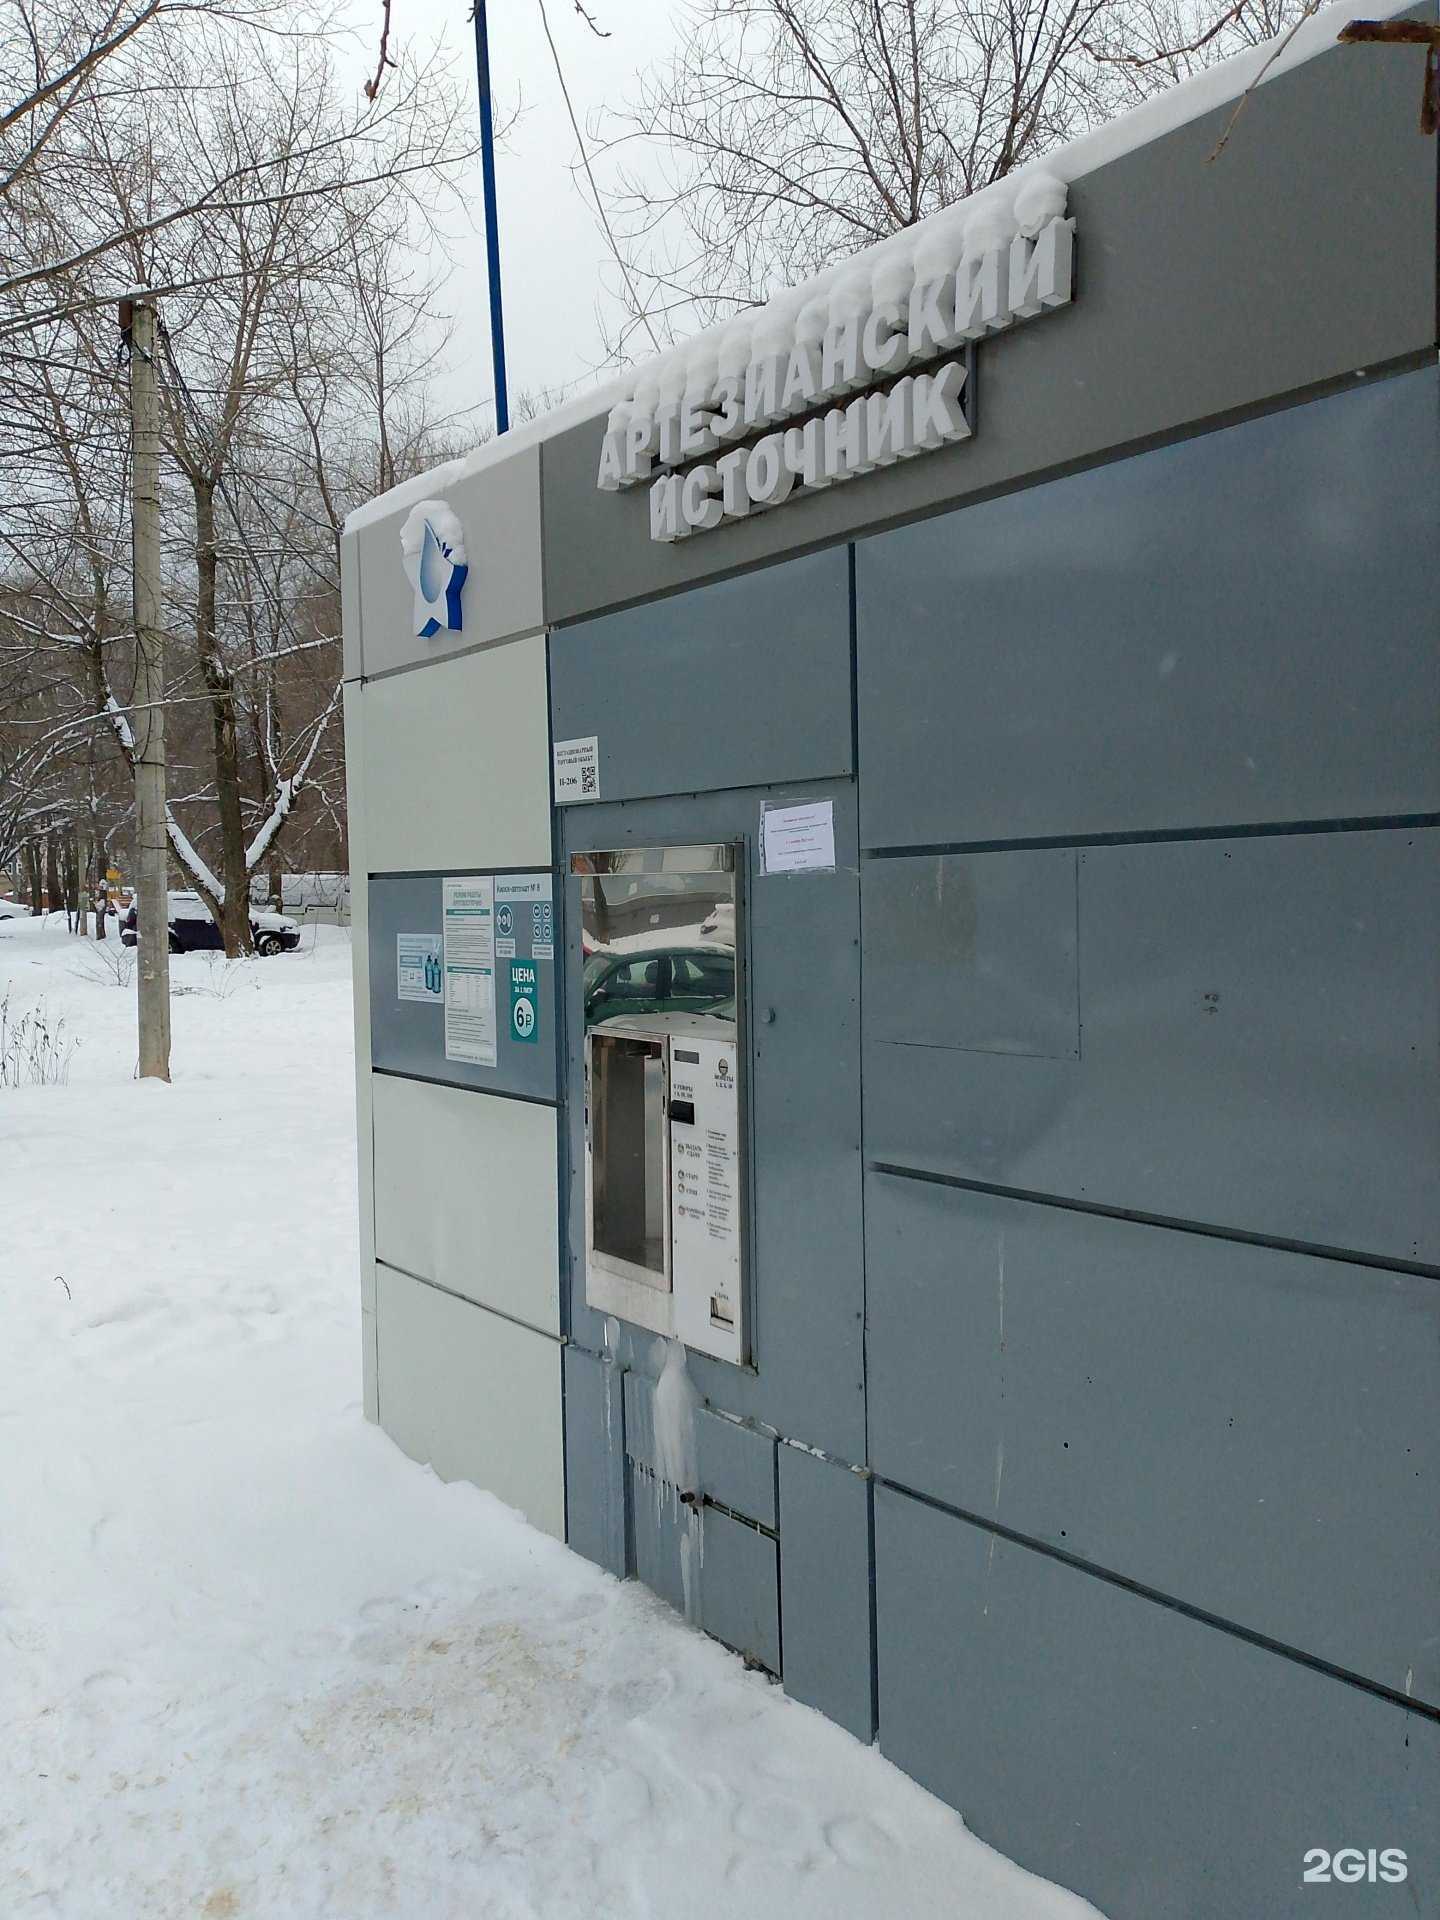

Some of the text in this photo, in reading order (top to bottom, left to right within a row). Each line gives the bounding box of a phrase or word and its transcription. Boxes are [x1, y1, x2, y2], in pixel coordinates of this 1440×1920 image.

[597, 214, 1076, 491] АРТЕЗИАНСКИЙ
[650, 362, 971, 542] ИСТОЧНИК
[512, 967, 535, 984] ЦЕНА
